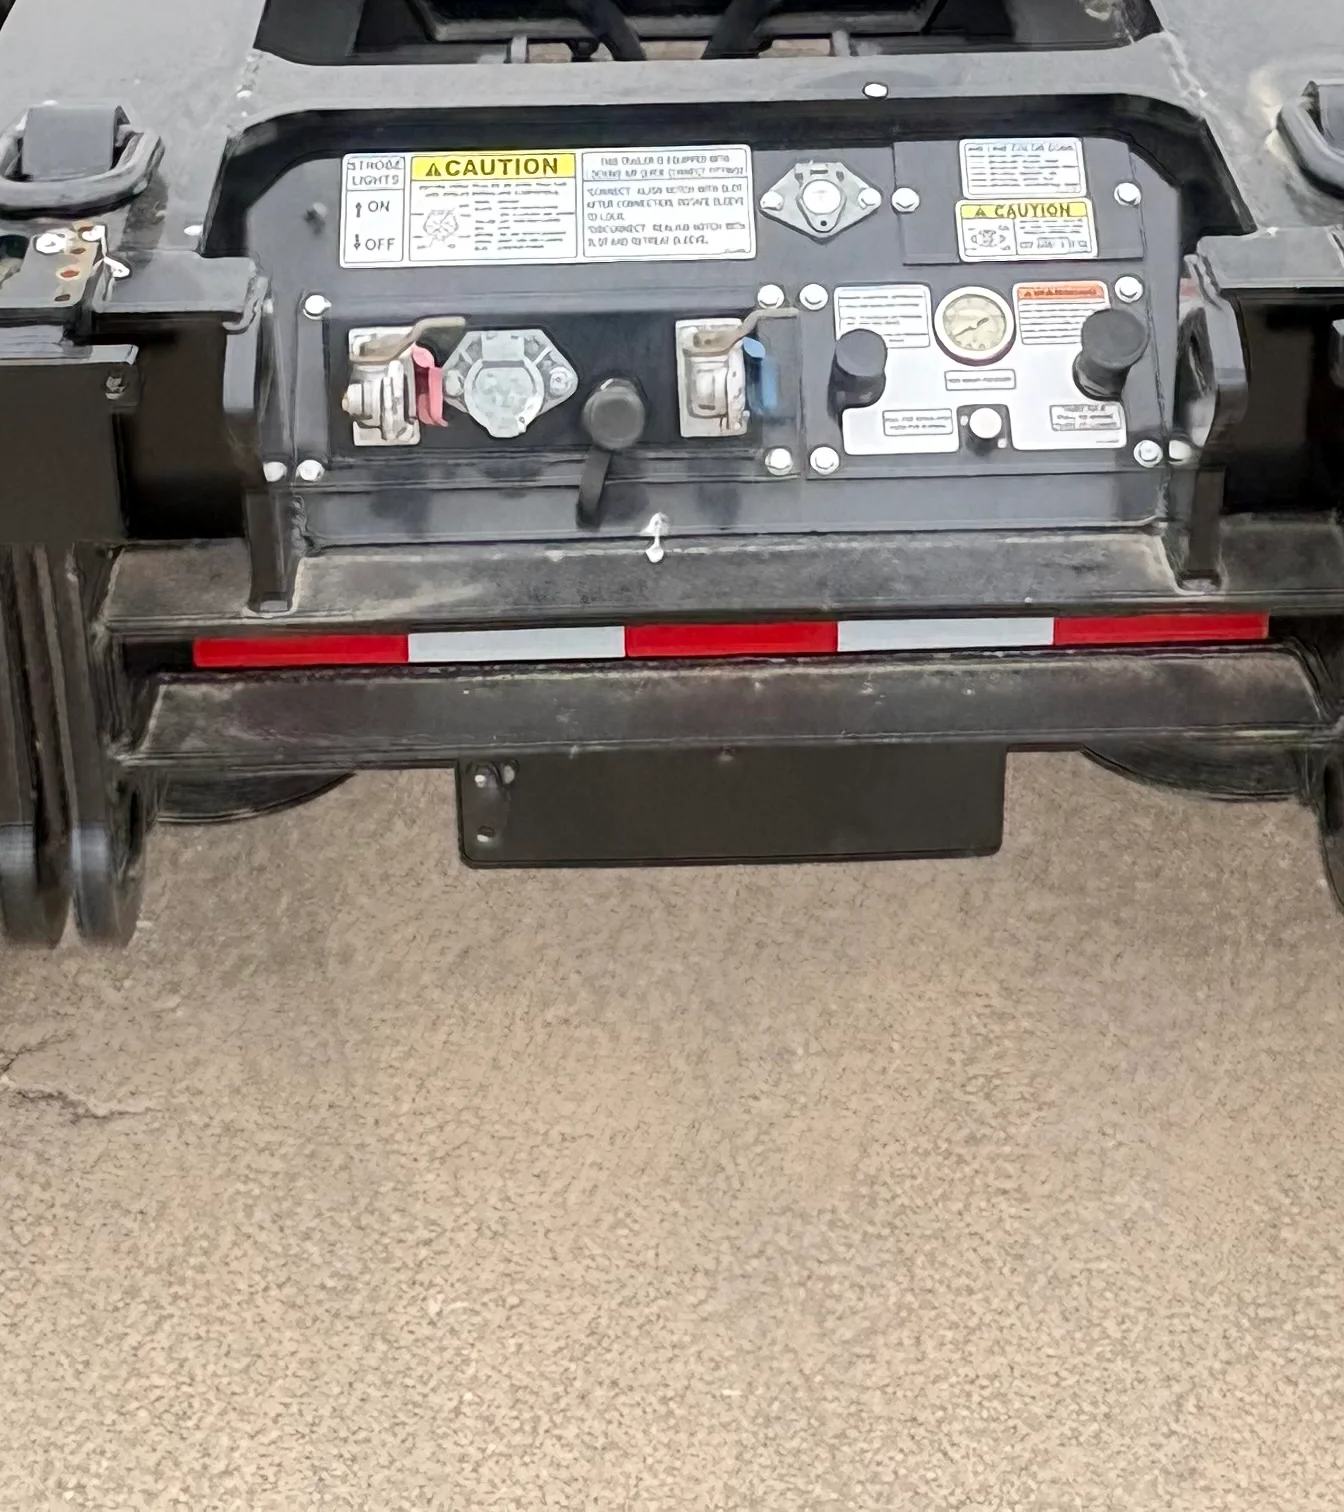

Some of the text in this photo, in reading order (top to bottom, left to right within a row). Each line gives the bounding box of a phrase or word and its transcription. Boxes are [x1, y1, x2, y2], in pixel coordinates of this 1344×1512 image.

[445, 158, 558, 176] CAUTION
[351, 174, 400, 186] LIGHTS
[367, 200, 390, 213] ON
[994, 203, 1071, 218] CAUTION
[364, 238, 396, 251] OFF
